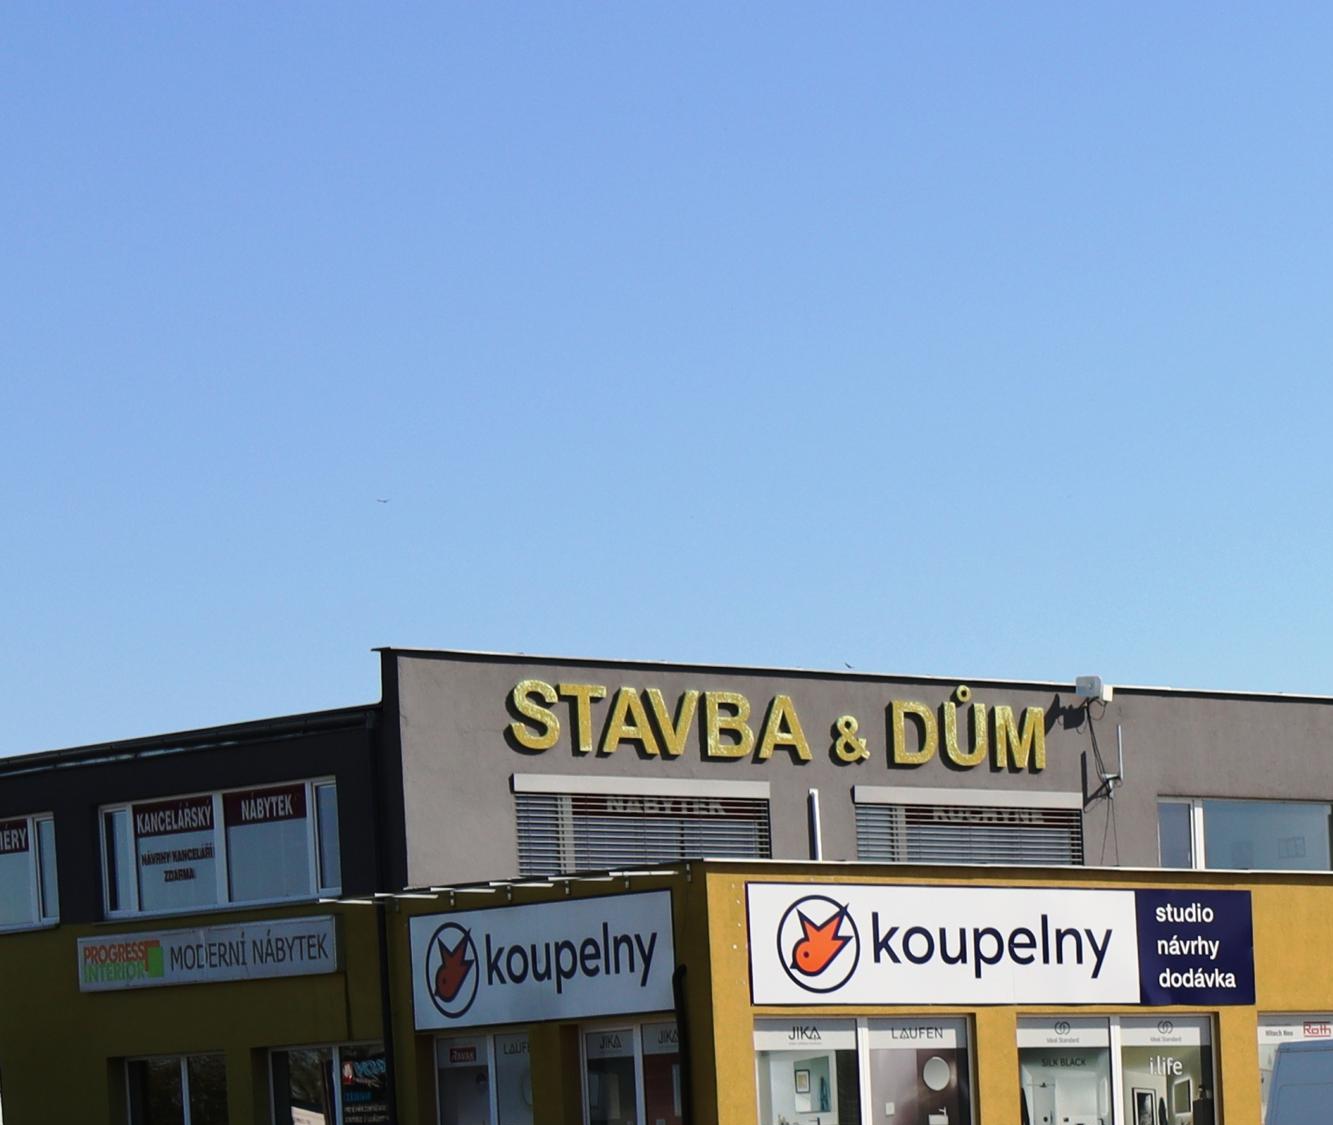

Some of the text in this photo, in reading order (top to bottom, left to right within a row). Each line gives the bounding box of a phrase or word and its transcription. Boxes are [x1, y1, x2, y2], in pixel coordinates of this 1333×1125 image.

[512, 679, 1047, 770] STAVBA & DŮM
[241, 791, 294, 822] NÁBYTEK
[1155, 903, 1214, 923] studio
[83, 940, 146, 966] PROGRESS
[252, 929, 329, 965] NÁBYTEK
[873, 911, 1113, 979] koupelny
[1157, 934, 1220, 960] návrhy
[485, 922, 658, 995] koupelny
[1158, 966, 1236, 989] dodávka
[788, 1026, 822, 1041] JIKA
[891, 1026, 944, 1040] LAUFEN
[1303, 1023, 1332, 1035] Roth
[1149, 1056, 1184, 1076] i.life
